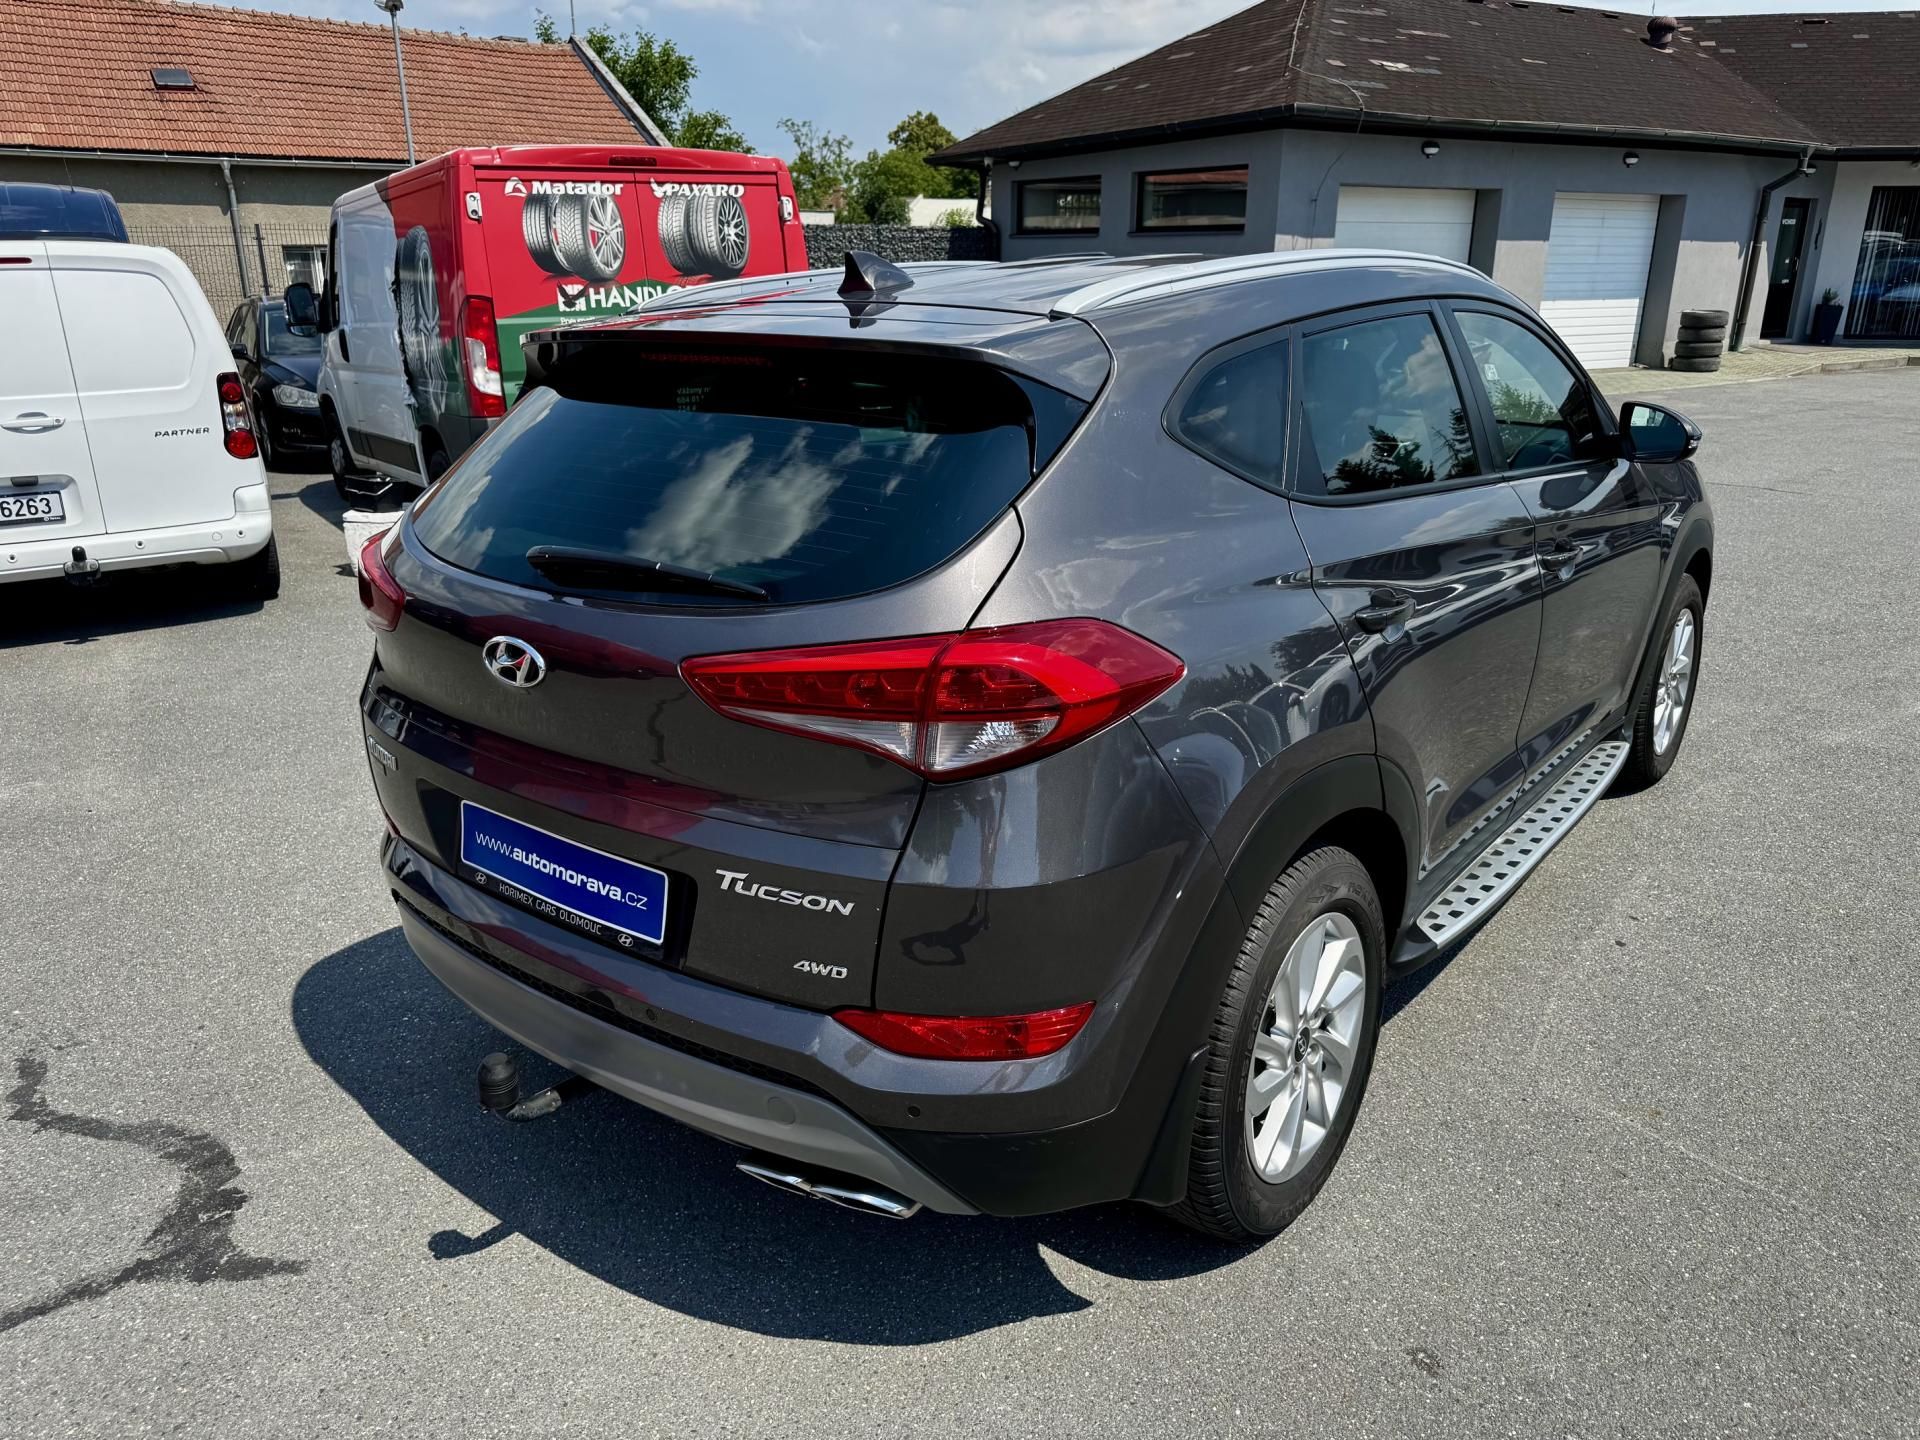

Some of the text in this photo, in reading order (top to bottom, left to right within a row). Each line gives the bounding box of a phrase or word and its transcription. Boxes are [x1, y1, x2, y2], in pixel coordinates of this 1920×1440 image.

[531, 181, 624, 196] Matador
[664, 183, 745, 198] PAXARO
[154, 427, 210, 438] PARTNER
[0, 497, 52, 518] 6263
[499, 882, 602, 935] HORIMEX CARS OLOMOUC
[793, 960, 848, 979] 4WD
